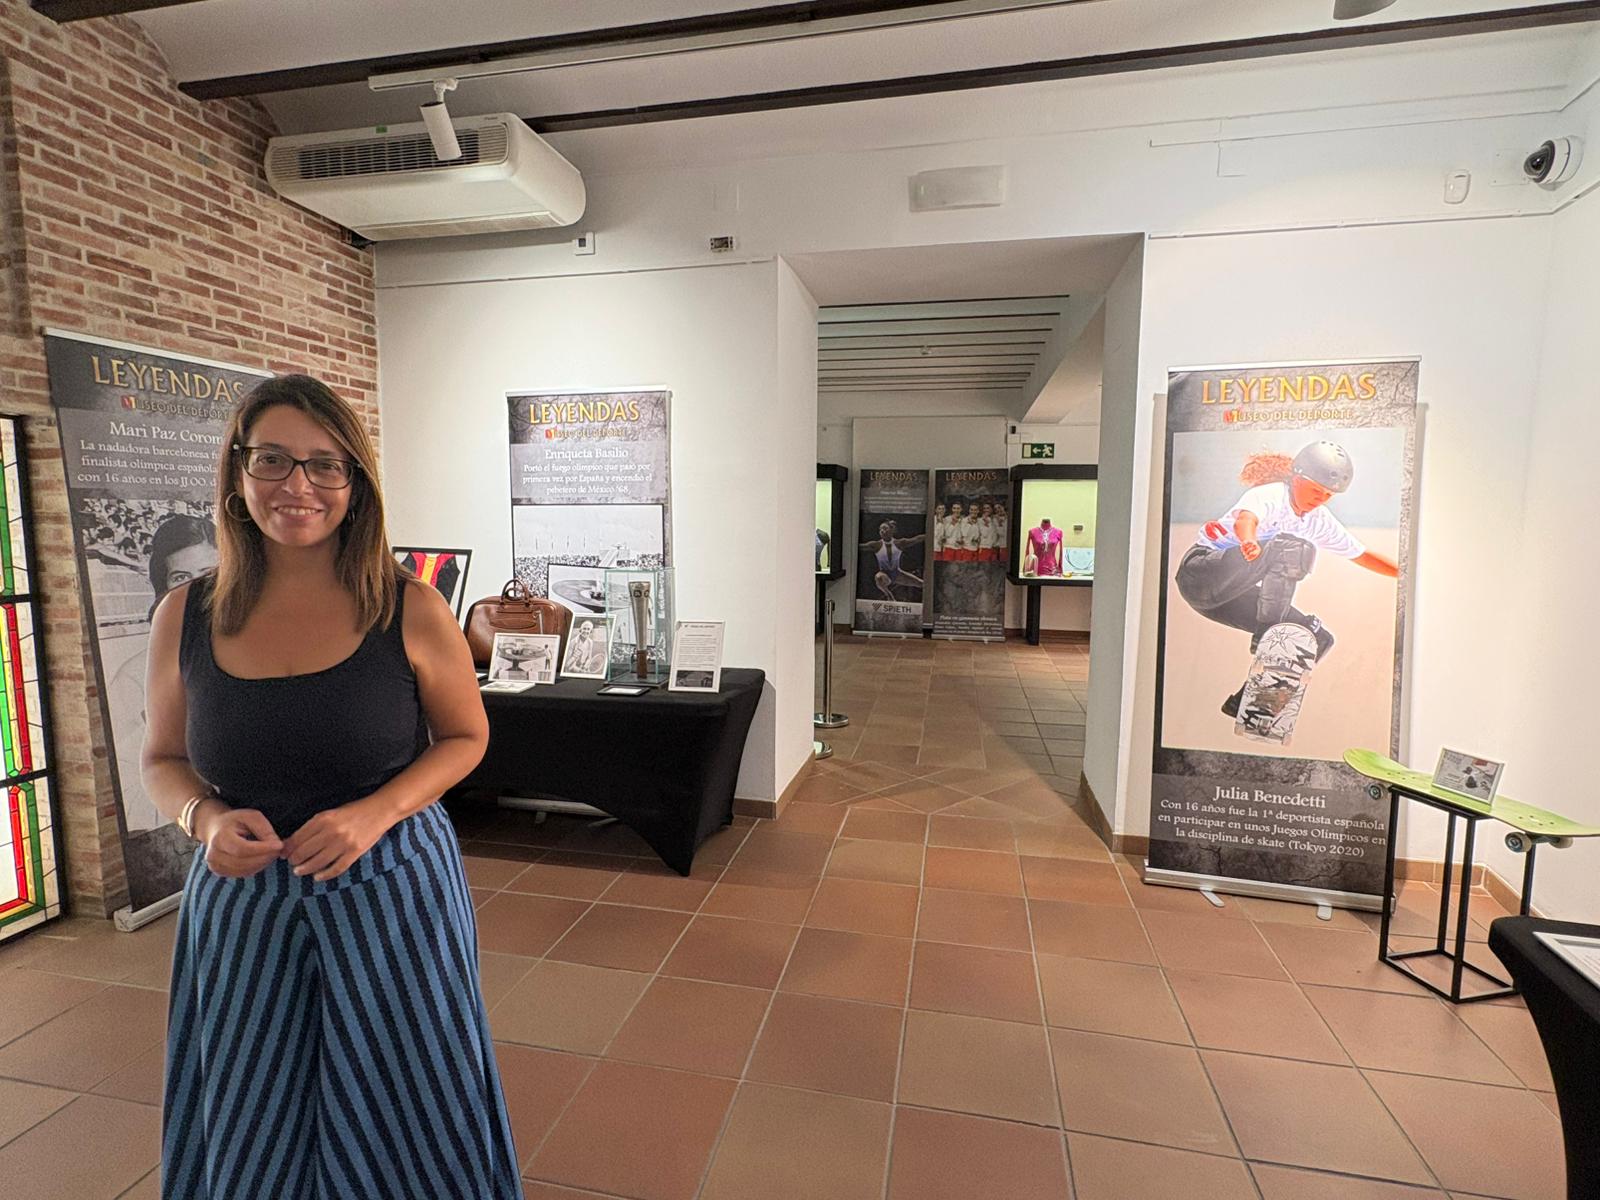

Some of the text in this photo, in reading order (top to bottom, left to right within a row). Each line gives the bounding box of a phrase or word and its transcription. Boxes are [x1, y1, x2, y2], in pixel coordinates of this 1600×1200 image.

[91, 354, 245, 404] LEYENDAS
[1201, 372, 1377, 405] LEYENDAS
[191, 406, 229, 420] DEPORT
[529, 400, 641, 424] LEYENDAS
[1272, 409, 1296, 421] DEL
[1299, 409, 1352, 421] DEPORTE
[110, 422, 224, 445] Mari Paz Corom
[80, 439, 95, 450] La
[98, 441, 151, 455] nadadora
[152, 445, 210, 460] barcelonesa
[545, 447, 629, 461] Enriqueta Basilio
[81, 455, 128, 468] finalista
[544, 463, 551, 472] el
[77, 473, 101, 482] con
[105, 473, 119, 483] 16
[121, 474, 147, 485] años
[149, 476, 163, 485] en
[164, 475, 178, 485] los
[522, 475, 551, 485] primera
[869, 471, 918, 481] LEYENDAS
[945, 471, 998, 481] LEYENDAS
[883, 604, 912, 614] SPIETH
[1212, 785, 1327, 809] Julia Benedetti
[1160, 799, 1182, 810] Con
[1186, 801, 1199, 811] 16
[1201, 804, 1226, 815] años
[1228, 805, 1246, 816] fue
[1248, 807, 1259, 817] la
[1275, 810, 1332, 825] deportista
[1334, 818, 1385, 831] española
[1158, 813, 1387, 846] en participar en unos Juegos Olímpicos en
[1175, 827, 1365, 857] la disciplina de skate (Tokyo 2020)
